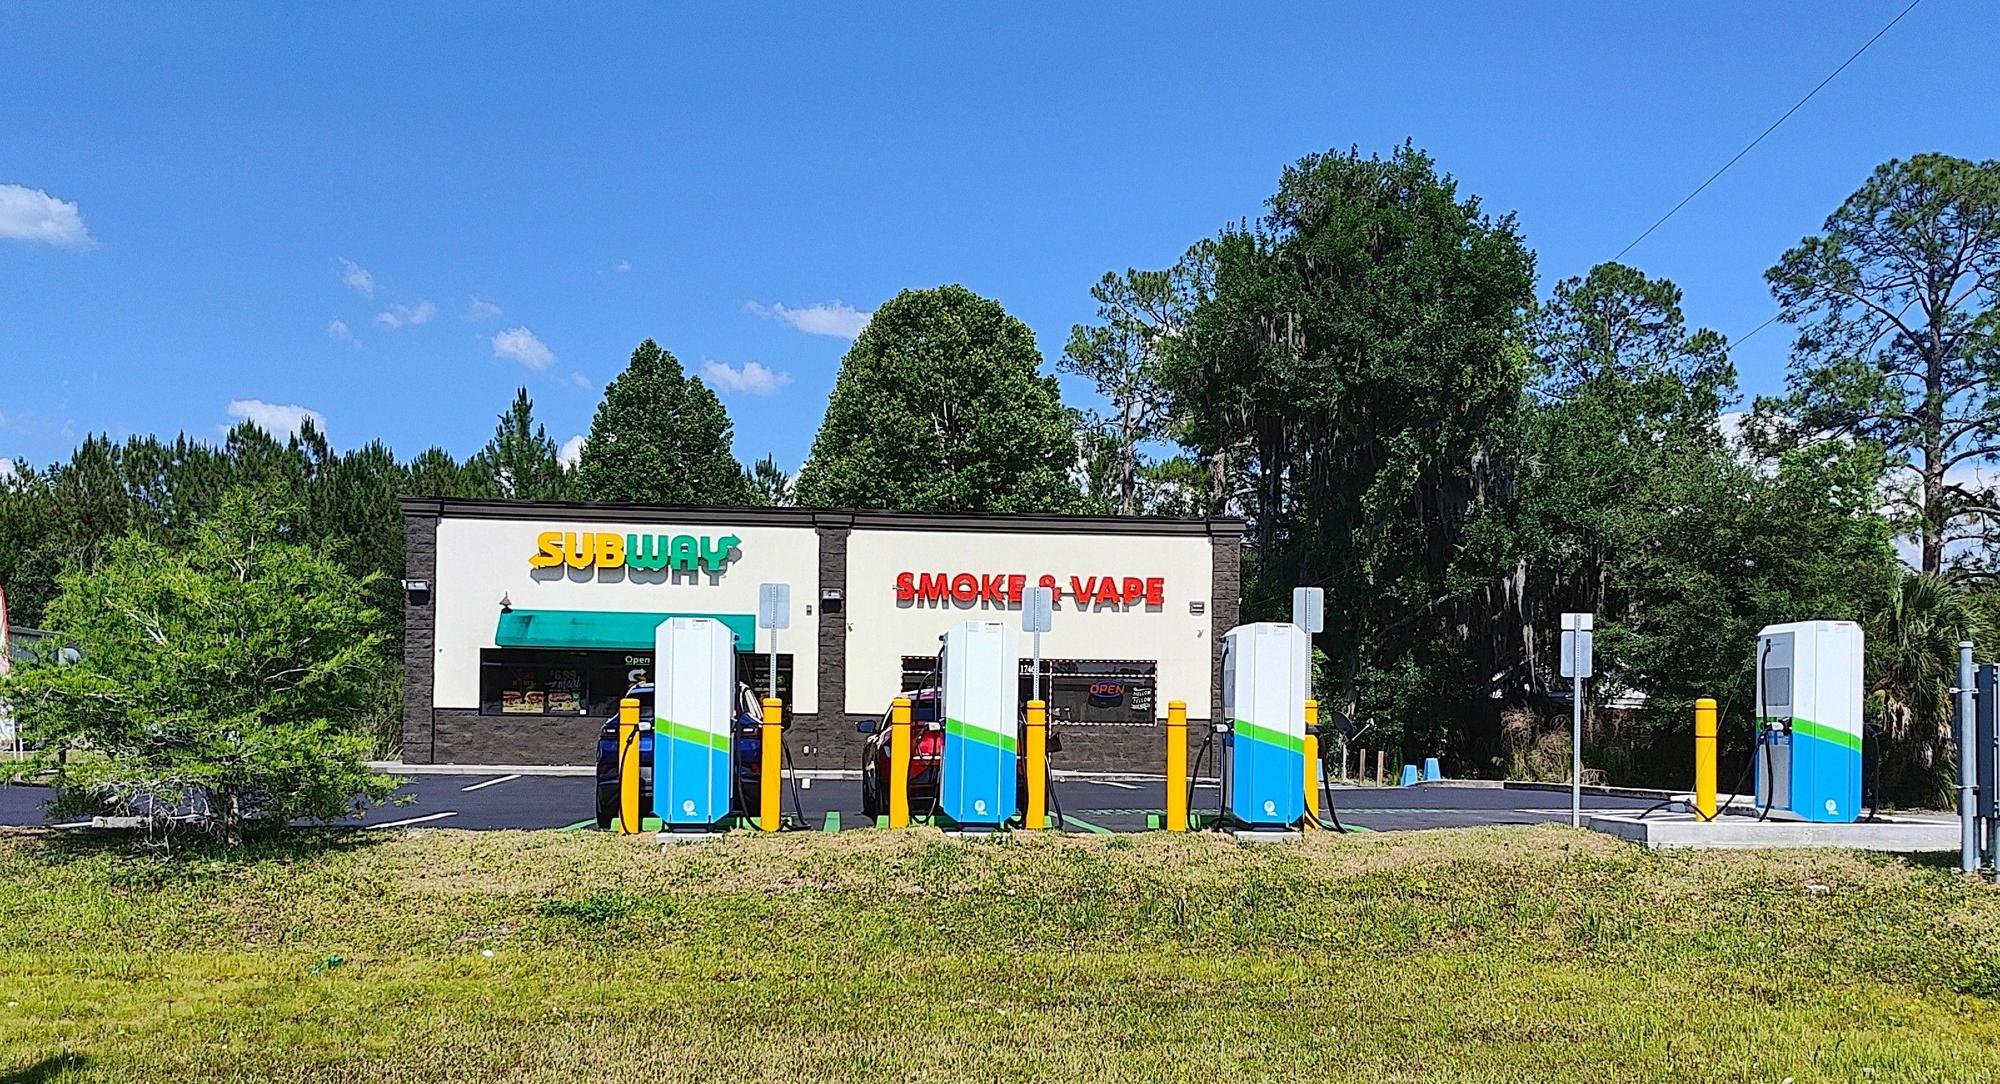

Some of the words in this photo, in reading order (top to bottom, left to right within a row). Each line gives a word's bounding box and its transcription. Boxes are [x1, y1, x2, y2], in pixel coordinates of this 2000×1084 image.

[528, 532, 742, 571] SUBWAY
[895, 571, 1026, 603] SMOKE
[1070, 576, 1164, 605] VAPE
[625, 656, 650, 665] Open
[1089, 684, 1125, 695] OPEN
